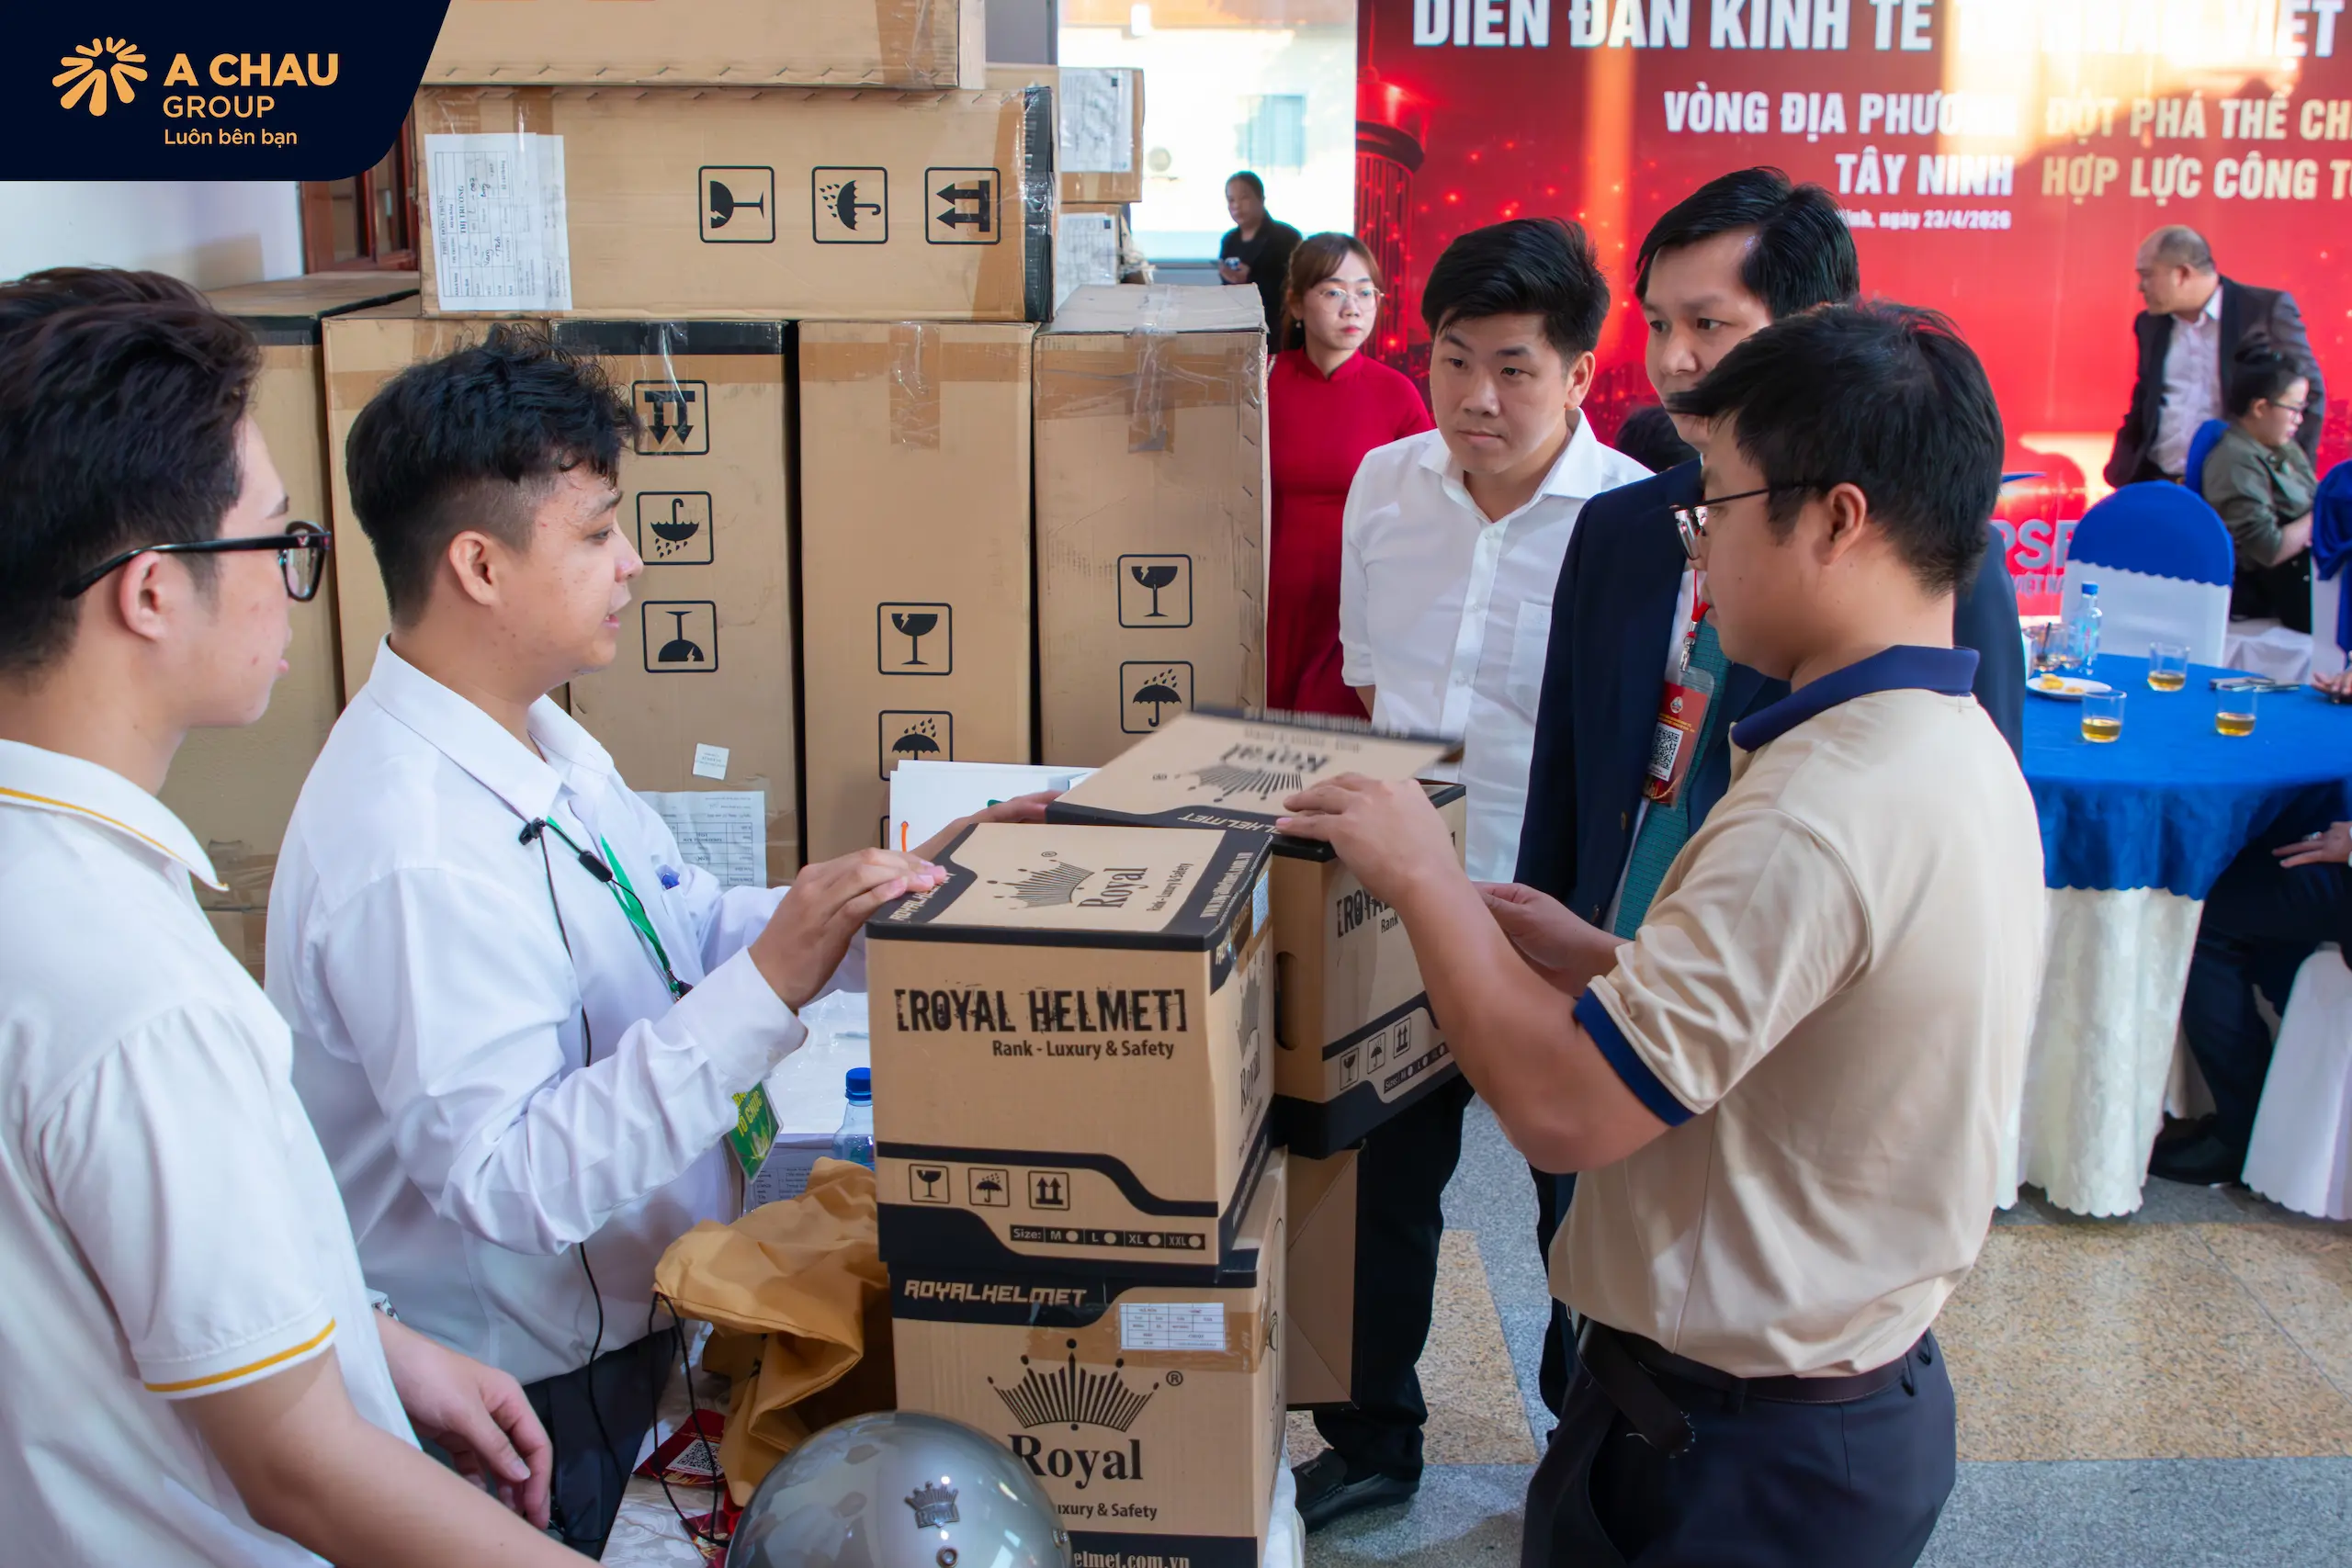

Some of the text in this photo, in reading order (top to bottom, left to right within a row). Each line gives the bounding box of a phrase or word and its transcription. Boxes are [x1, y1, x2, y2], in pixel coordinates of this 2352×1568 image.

[1710, 0, 1850, 51] KINH
[1663, 81, 1770, 134] VÒNG
[1780, 93, 1848, 143] ĐỊA
[2130, 88, 2206, 139] PHÁ
[2219, 84, 2290, 140] THẾ
[2299, 98, 2352, 141] CH
[1836, 145, 2014, 197] TÂY NINH
[2041, 150, 2352, 207] HỢP LỰC CÔNG T
[1077, 867, 1149, 908] Royal
[1381, 911, 1398, 933] Rank
[993, 1040, 1033, 1056] Rank
[1046, 1041, 1102, 1061] Luxury
[1105, 1041, 1118, 1056] &
[1122, 1040, 1175, 1060] Safety
[1013, 1228, 1186, 1247] Size: M L XL XXL
[904, 1280, 1088, 1308] ROYALHELMET
[1007, 1434, 1144, 1489] Royal
[1097, 1503, 1108, 1517] &
[1112, 1503, 1158, 1521] Safety
